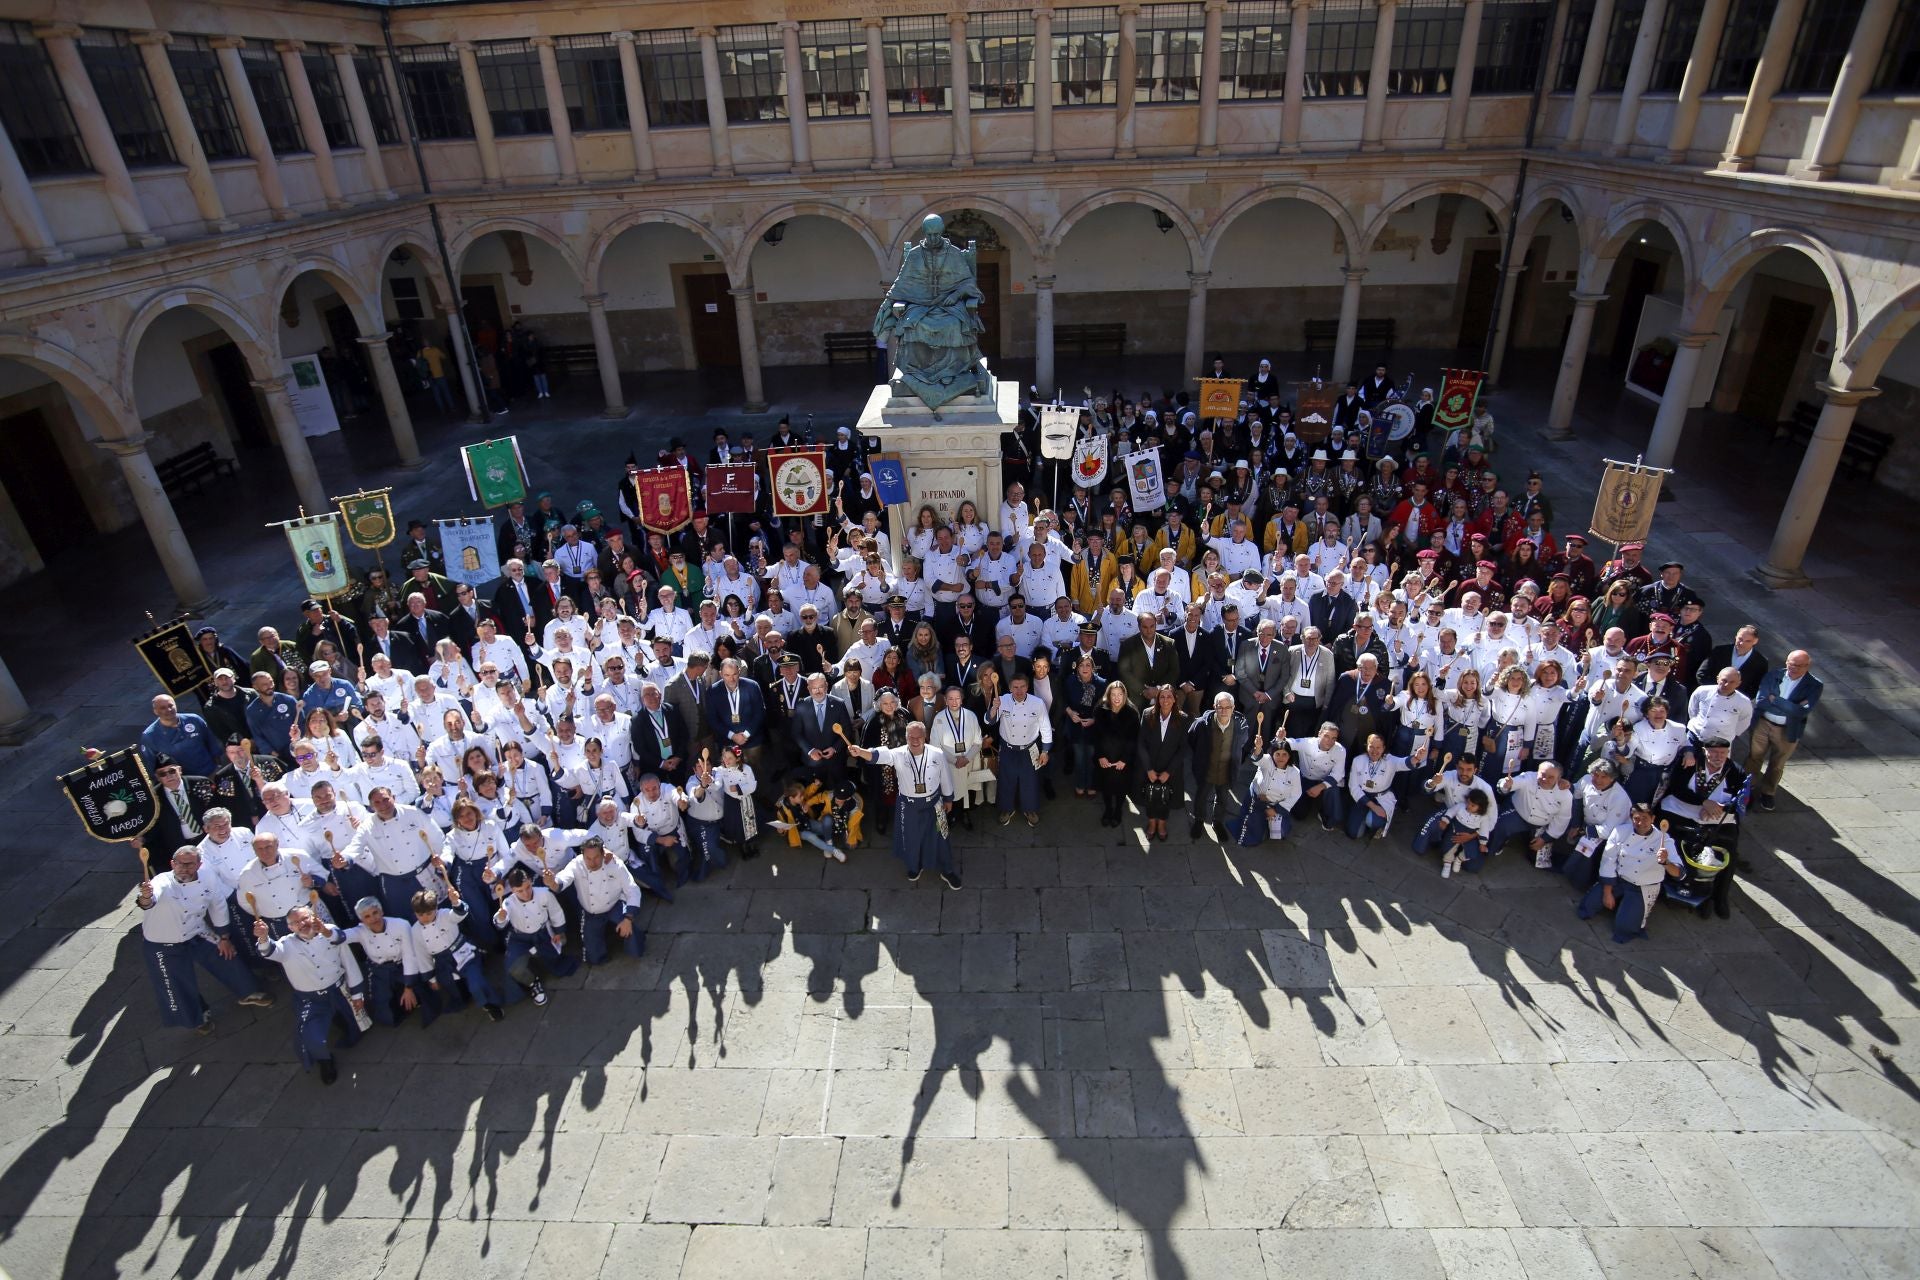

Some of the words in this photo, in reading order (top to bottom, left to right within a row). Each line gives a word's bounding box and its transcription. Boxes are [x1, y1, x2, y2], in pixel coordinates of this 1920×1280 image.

[1449, 379, 1476, 387] CANTABRIA
[784, 460, 794, 468] DEL
[726, 473, 736, 484] F
[929, 489, 966, 499] FERNANDO
[792, 500, 815, 511] NAVARRA
[939, 502, 949, 512] DE
[89, 770, 125, 791] AMIGOS
[128, 778, 142, 788] DE
[135, 790, 148, 803] LOS
[80, 794, 104, 826] COFRADIA
[111, 814, 144, 835] NABOS
